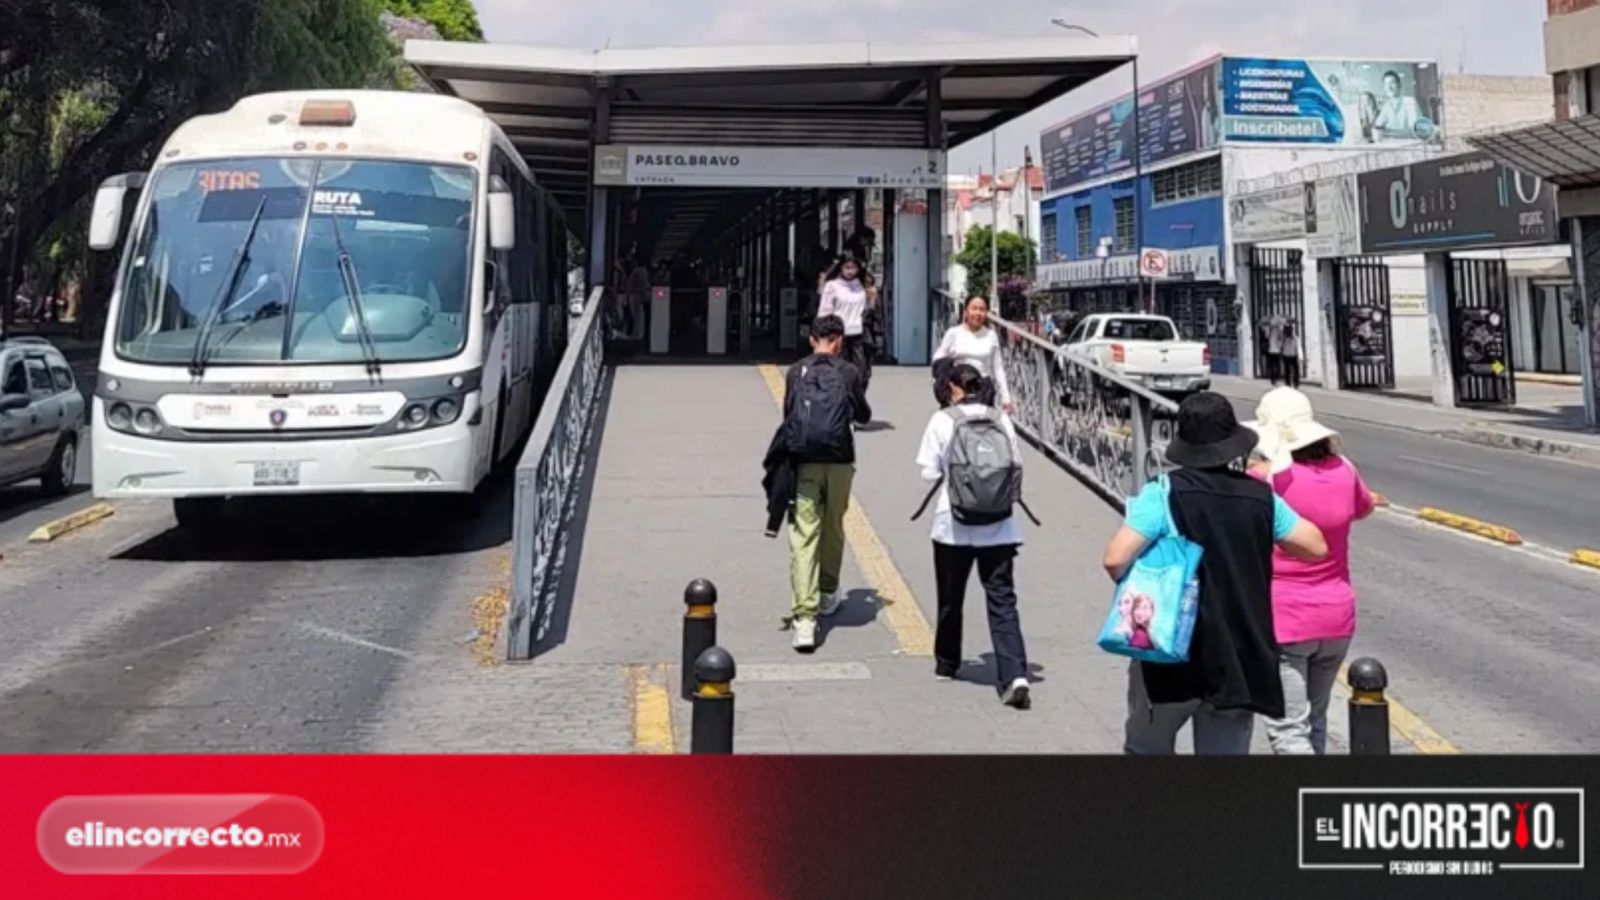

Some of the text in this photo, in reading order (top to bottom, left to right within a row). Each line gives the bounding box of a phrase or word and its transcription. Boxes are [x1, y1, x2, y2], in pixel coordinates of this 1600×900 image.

[689, 155, 740, 166] BRAVO
[928, 161, 937, 174] 2
[313, 190, 362, 206] RUTA
[1413, 220, 1453, 234] SUPPLY
